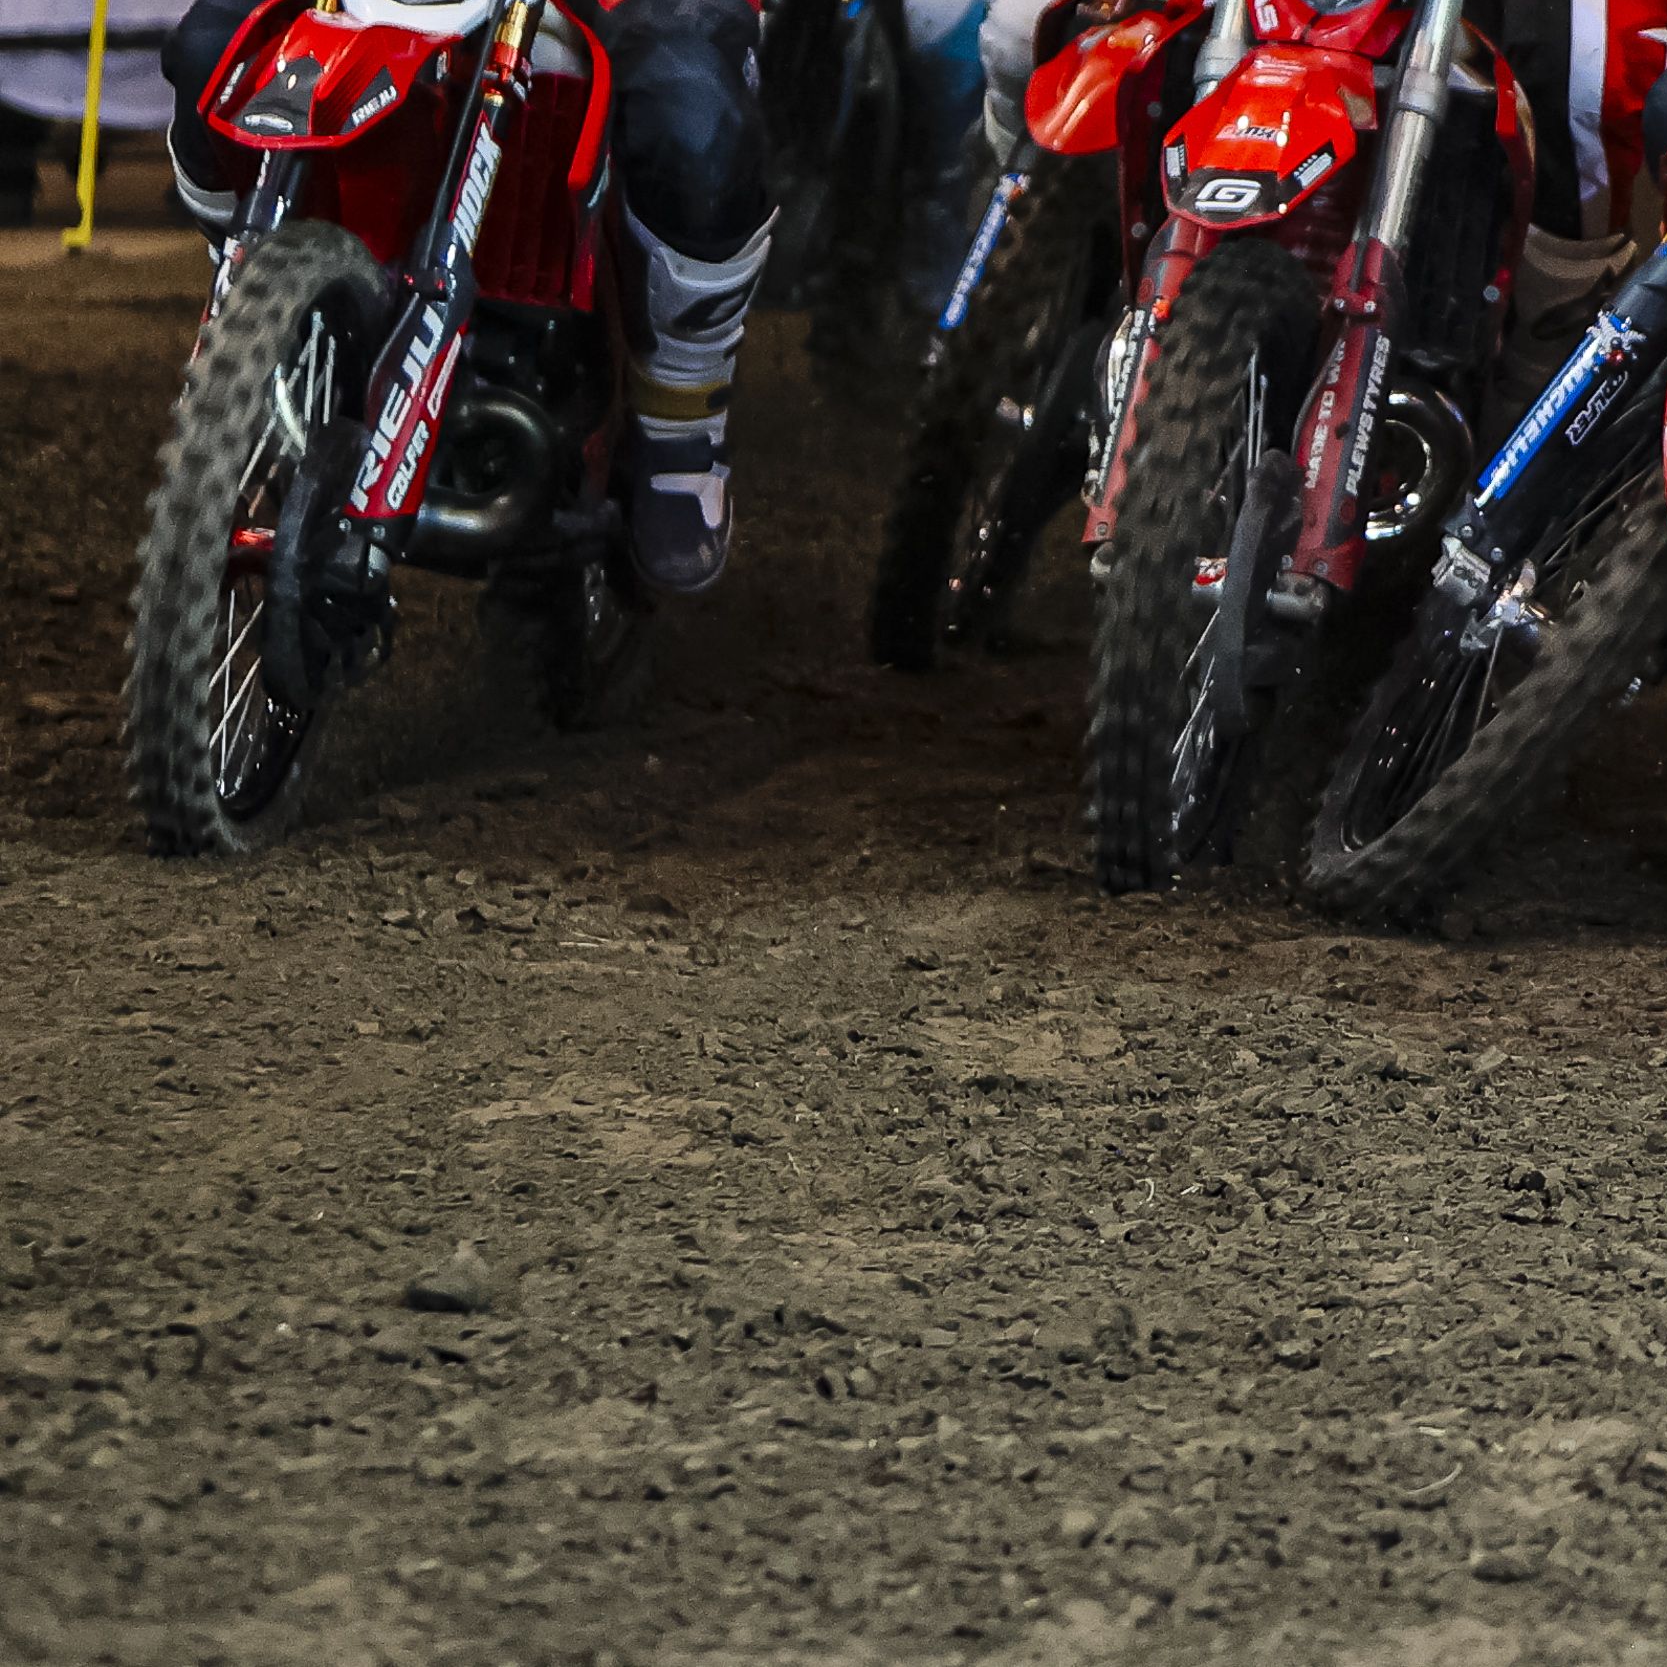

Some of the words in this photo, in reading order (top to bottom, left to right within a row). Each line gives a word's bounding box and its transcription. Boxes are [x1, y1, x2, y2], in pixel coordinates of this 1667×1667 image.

[348, 302, 446, 514] RIEJU
[1361, 333, 1392, 411] TYRES
[1303, 422, 1330, 490] MADE
[1344, 410, 1376, 497] PLEWS
